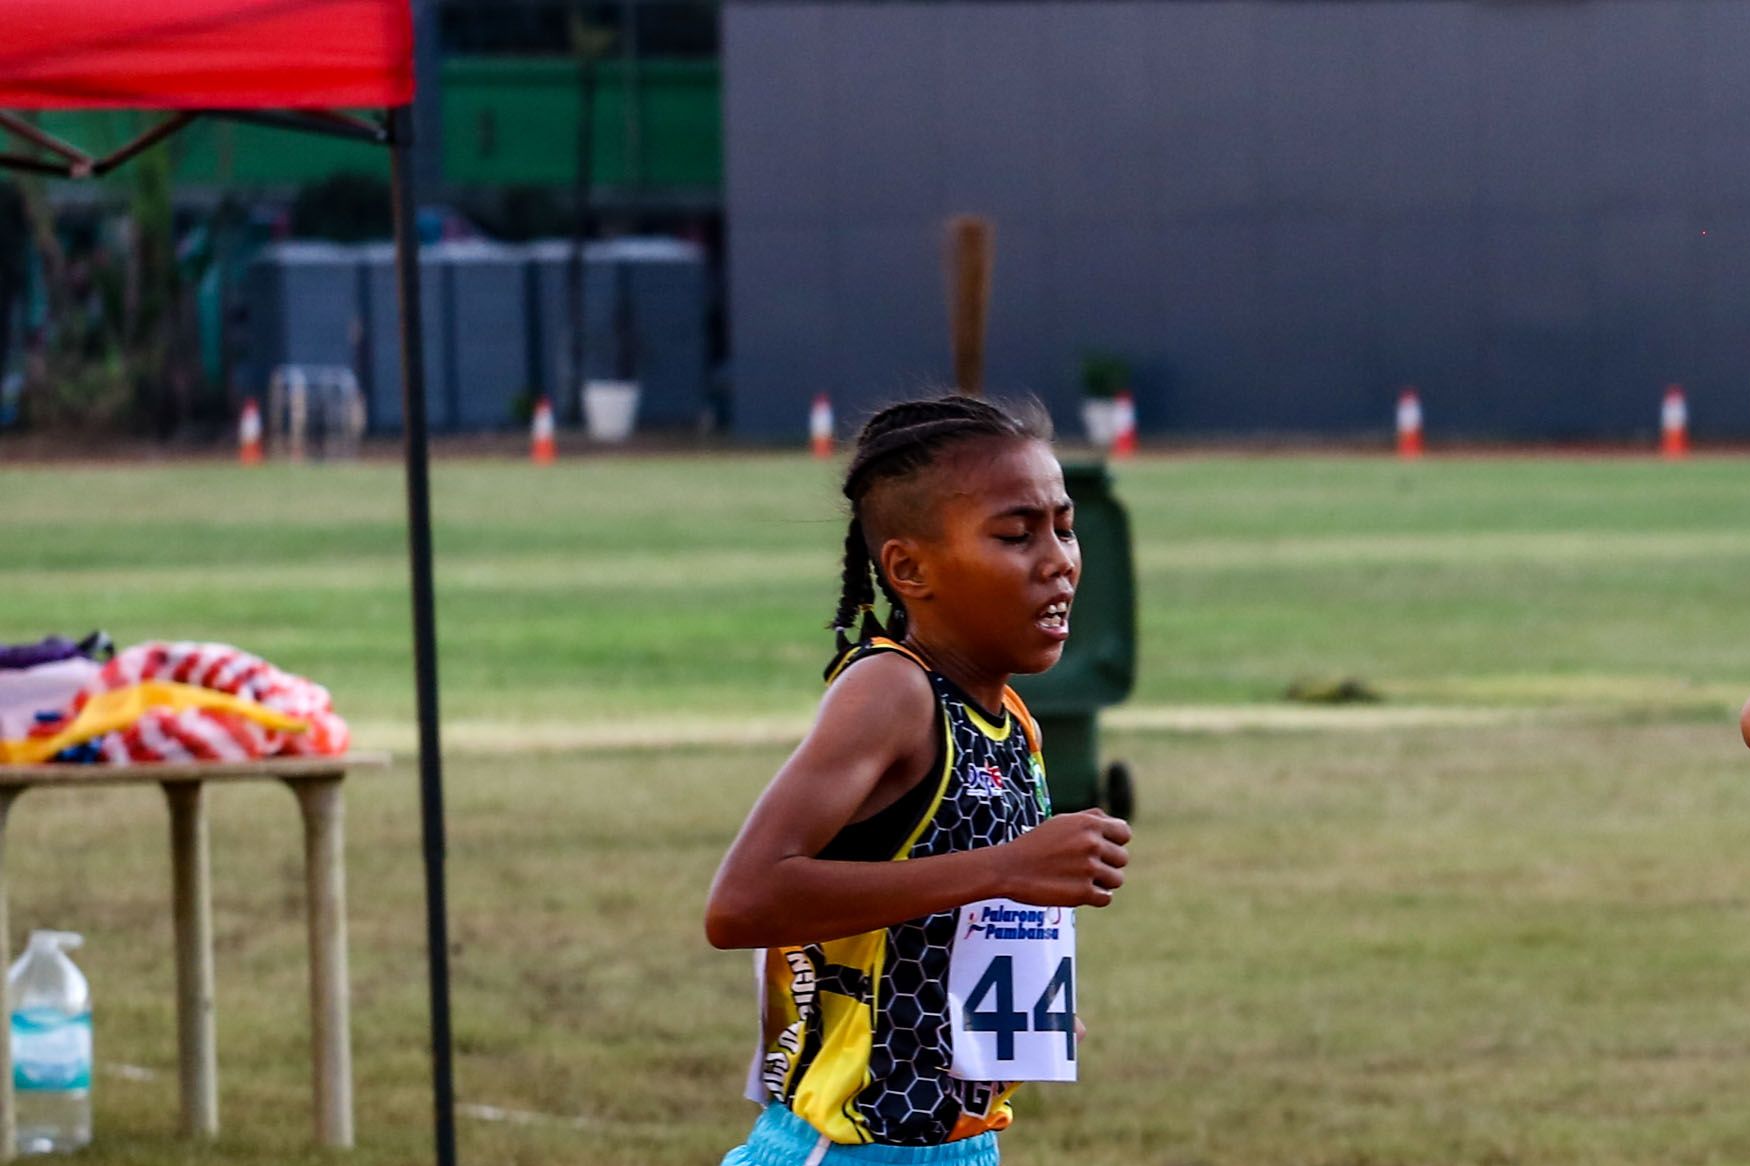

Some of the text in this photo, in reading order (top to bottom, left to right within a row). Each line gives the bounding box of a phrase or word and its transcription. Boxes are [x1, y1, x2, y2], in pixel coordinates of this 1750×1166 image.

[981, 904, 1046, 928] Palarong
[985, 922, 1059, 940] Pambansa
[962, 954, 1076, 1061] 44
